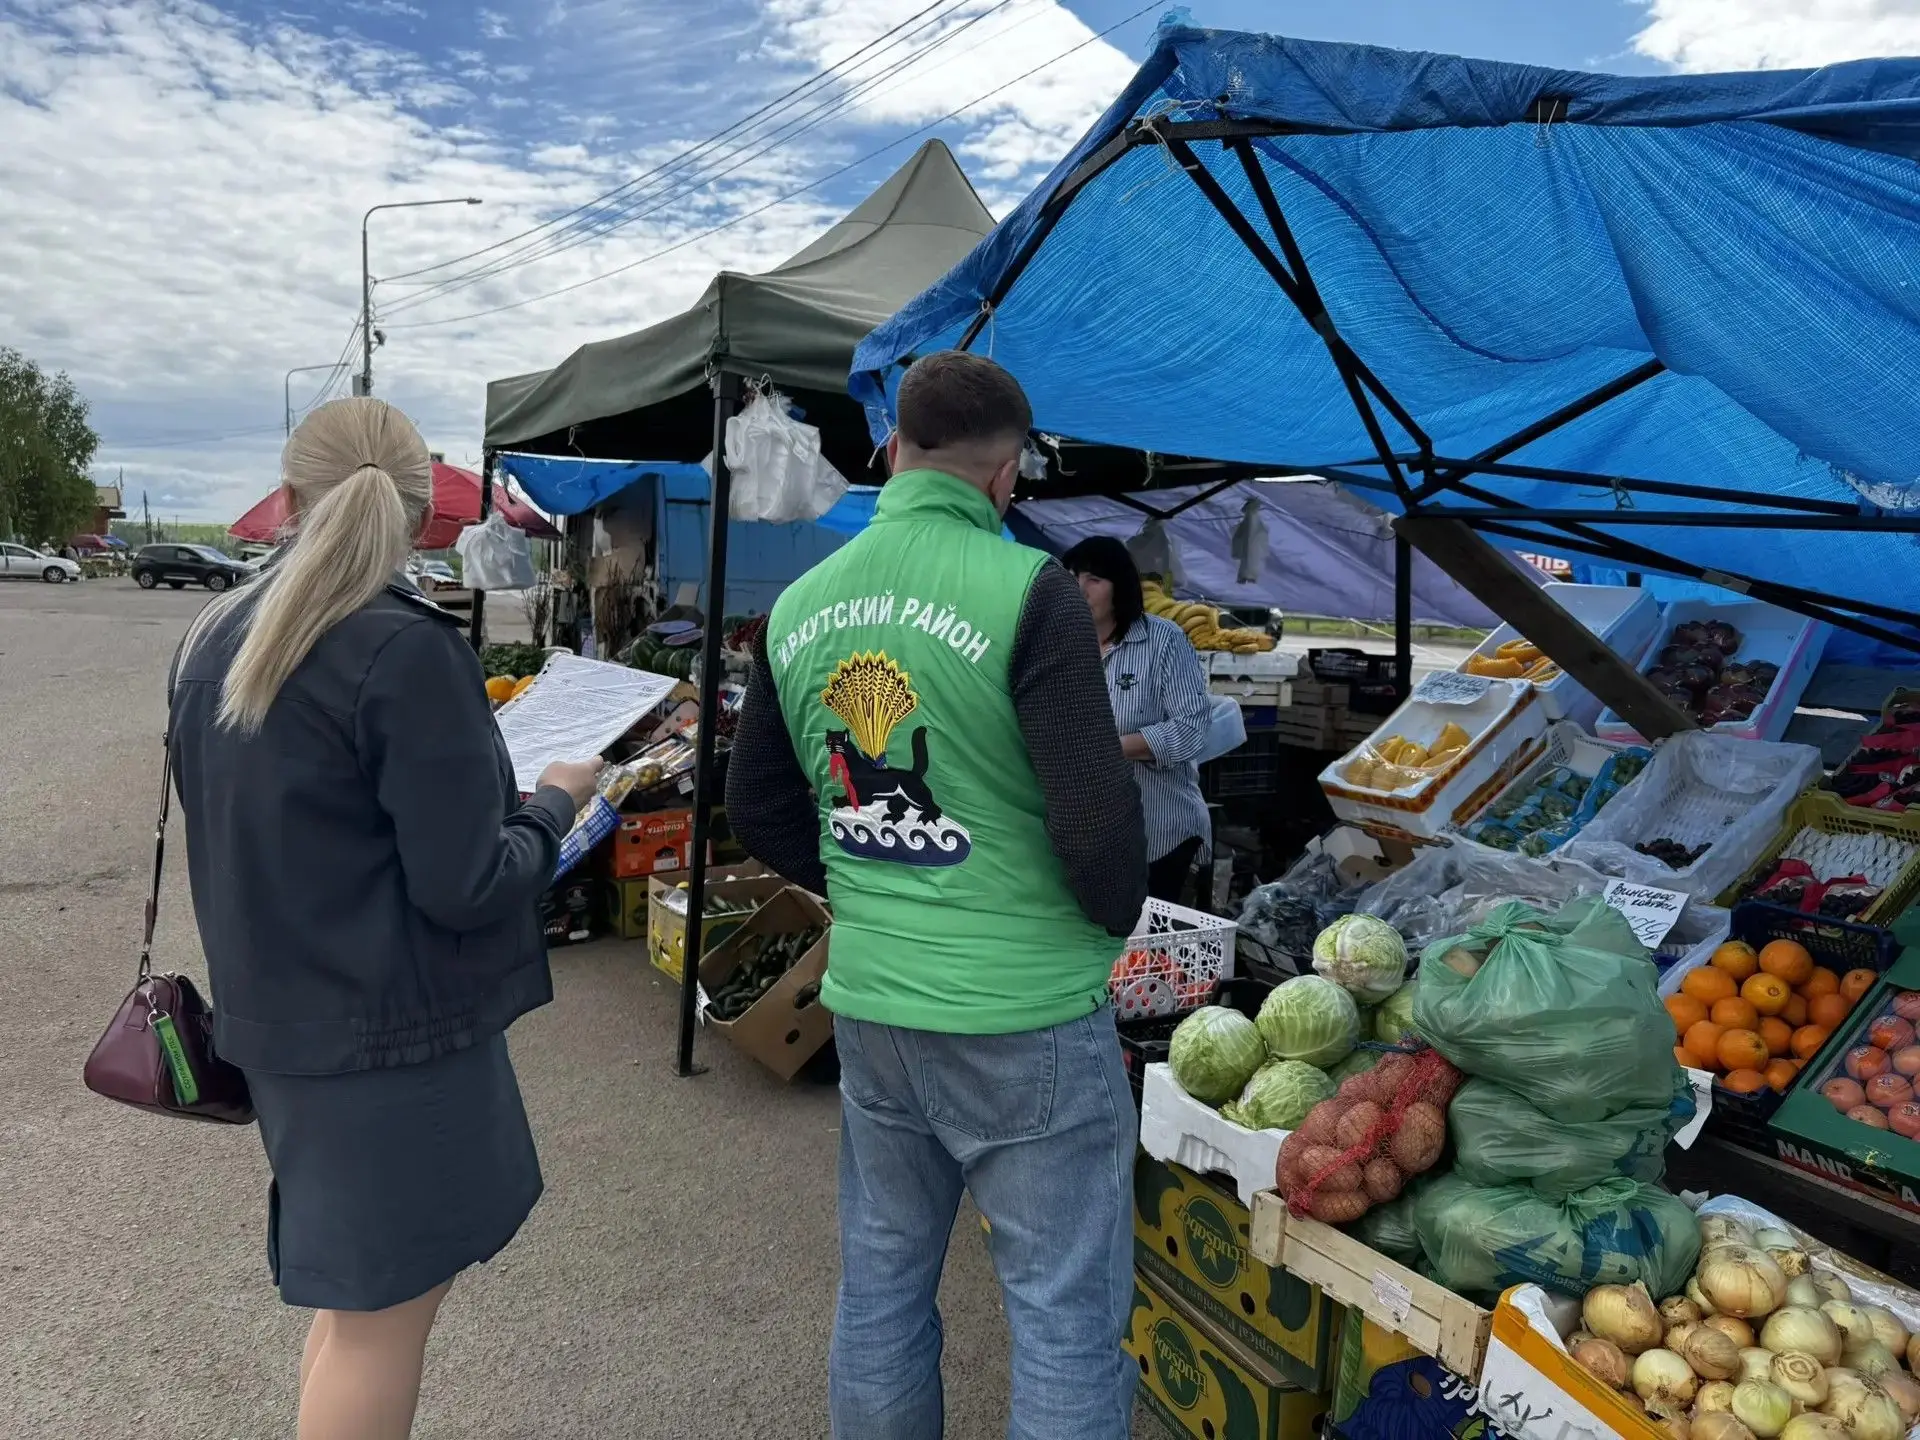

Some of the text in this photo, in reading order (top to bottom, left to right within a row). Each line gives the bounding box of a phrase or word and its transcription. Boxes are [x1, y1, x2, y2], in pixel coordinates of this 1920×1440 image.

[777, 589, 992, 668] ИРКУТСКИЙ РАЙОН
[1174, 1203, 1249, 1272] Ecuasabor
[1186, 1284, 1237, 1333] Premium
[1144, 1322, 1209, 1399] Ecuasabor
